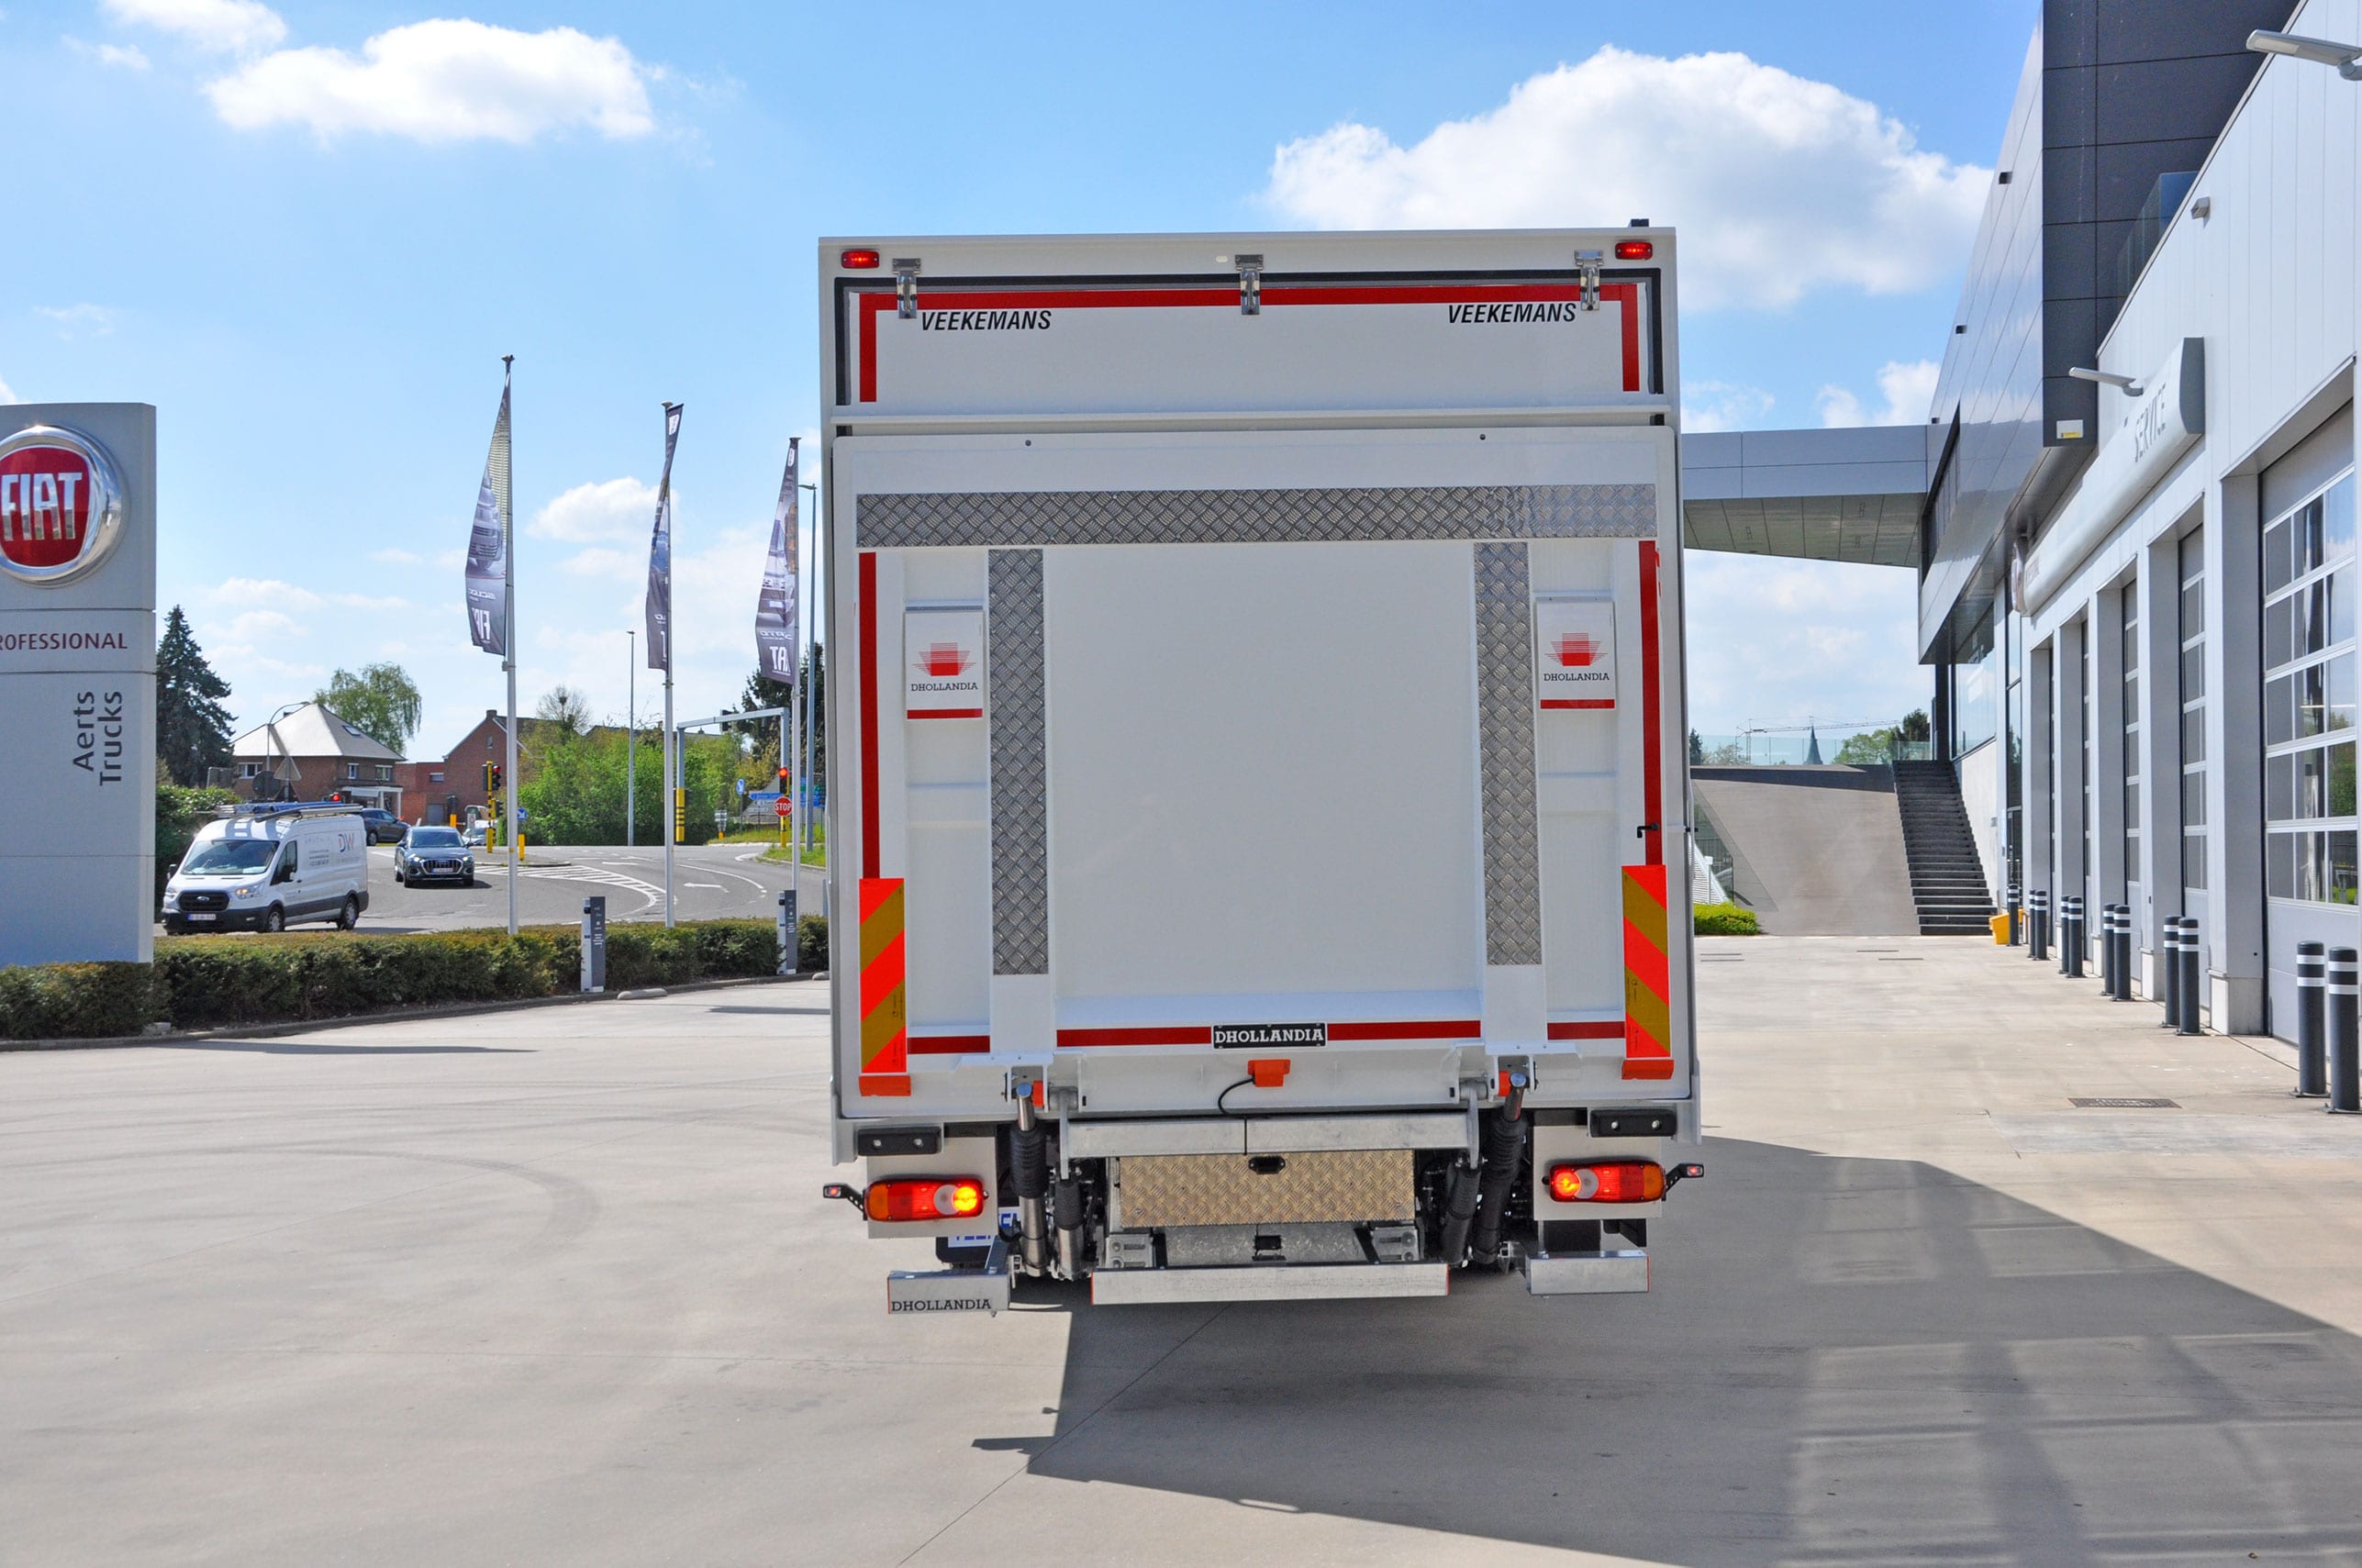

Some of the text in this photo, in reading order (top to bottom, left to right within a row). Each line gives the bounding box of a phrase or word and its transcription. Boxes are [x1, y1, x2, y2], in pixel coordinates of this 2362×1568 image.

[921, 310, 1053, 331] VEEKEMANS
[1448, 303, 1577, 324] VEEKEMANS
[1, 472, 84, 542] FIAT
[1543, 673, 1610, 682] DHOLLANDIA
[910, 682, 979, 692] DHOLLANDIA
[72, 691, 95, 773] Aerts
[97, 691, 122, 786] Trucks
[774, 803, 792, 811] STOP
[1214, 1029, 1324, 1044] DHOLLANDIA
[891, 1298, 992, 1312] DHOLLANDIA
